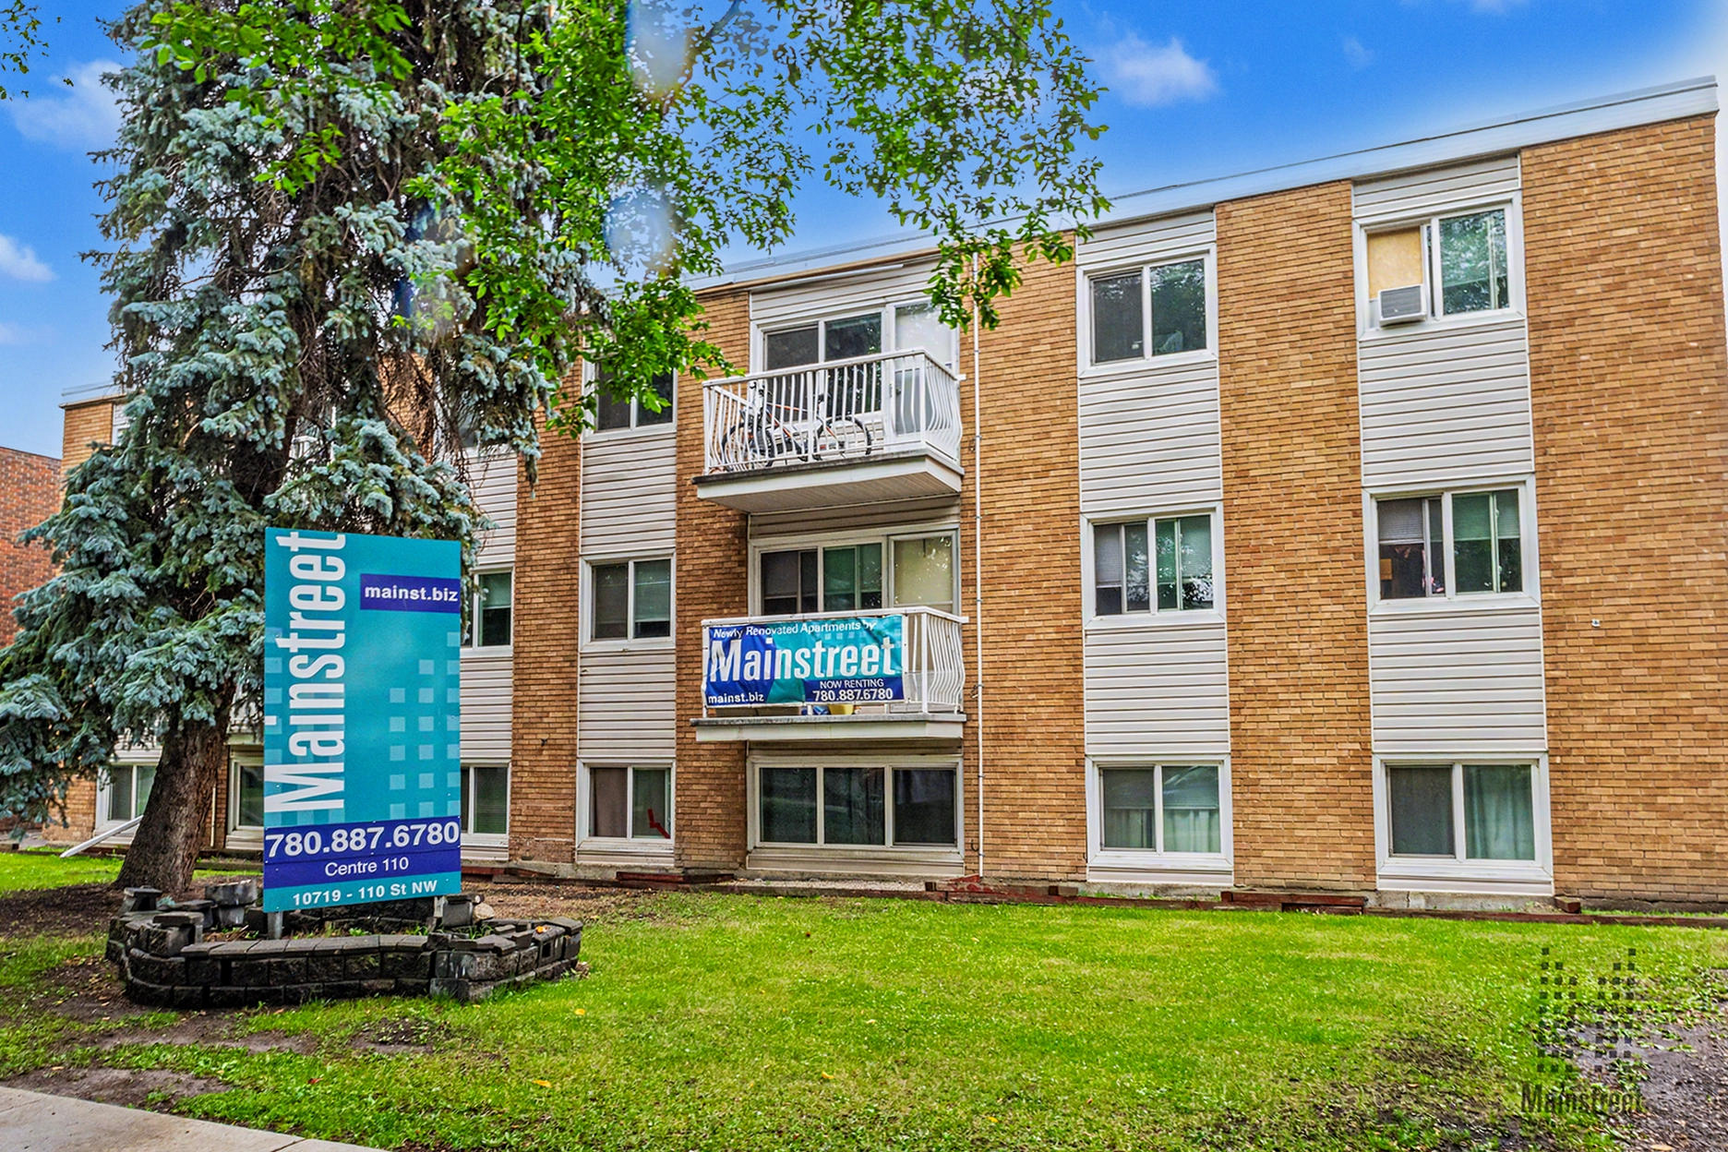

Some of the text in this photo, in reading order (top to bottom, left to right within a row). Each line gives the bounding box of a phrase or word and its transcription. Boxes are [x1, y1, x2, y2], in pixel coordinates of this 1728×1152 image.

[364, 584, 458, 603] mainst.biz
[713, 628, 743, 640] Newly
[746, 624, 799, 636] Renovated
[800, 621, 861, 634] Apartments
[709, 637, 896, 683] Mainstreet
[265, 531, 346, 813] Mainstreet
[819, 678, 884, 689] NOW RENTING
[708, 691, 765, 704] mainst.biz
[812, 688, 893, 702] 780.887.6780
[265, 821, 460, 859] 780.887.6780
[324, 857, 409, 878] Centre 110
[292, 889, 341, 907] 10719
[358, 885, 385, 900] 110
[389, 883, 407, 898] St
[411, 880, 438, 895] NW
